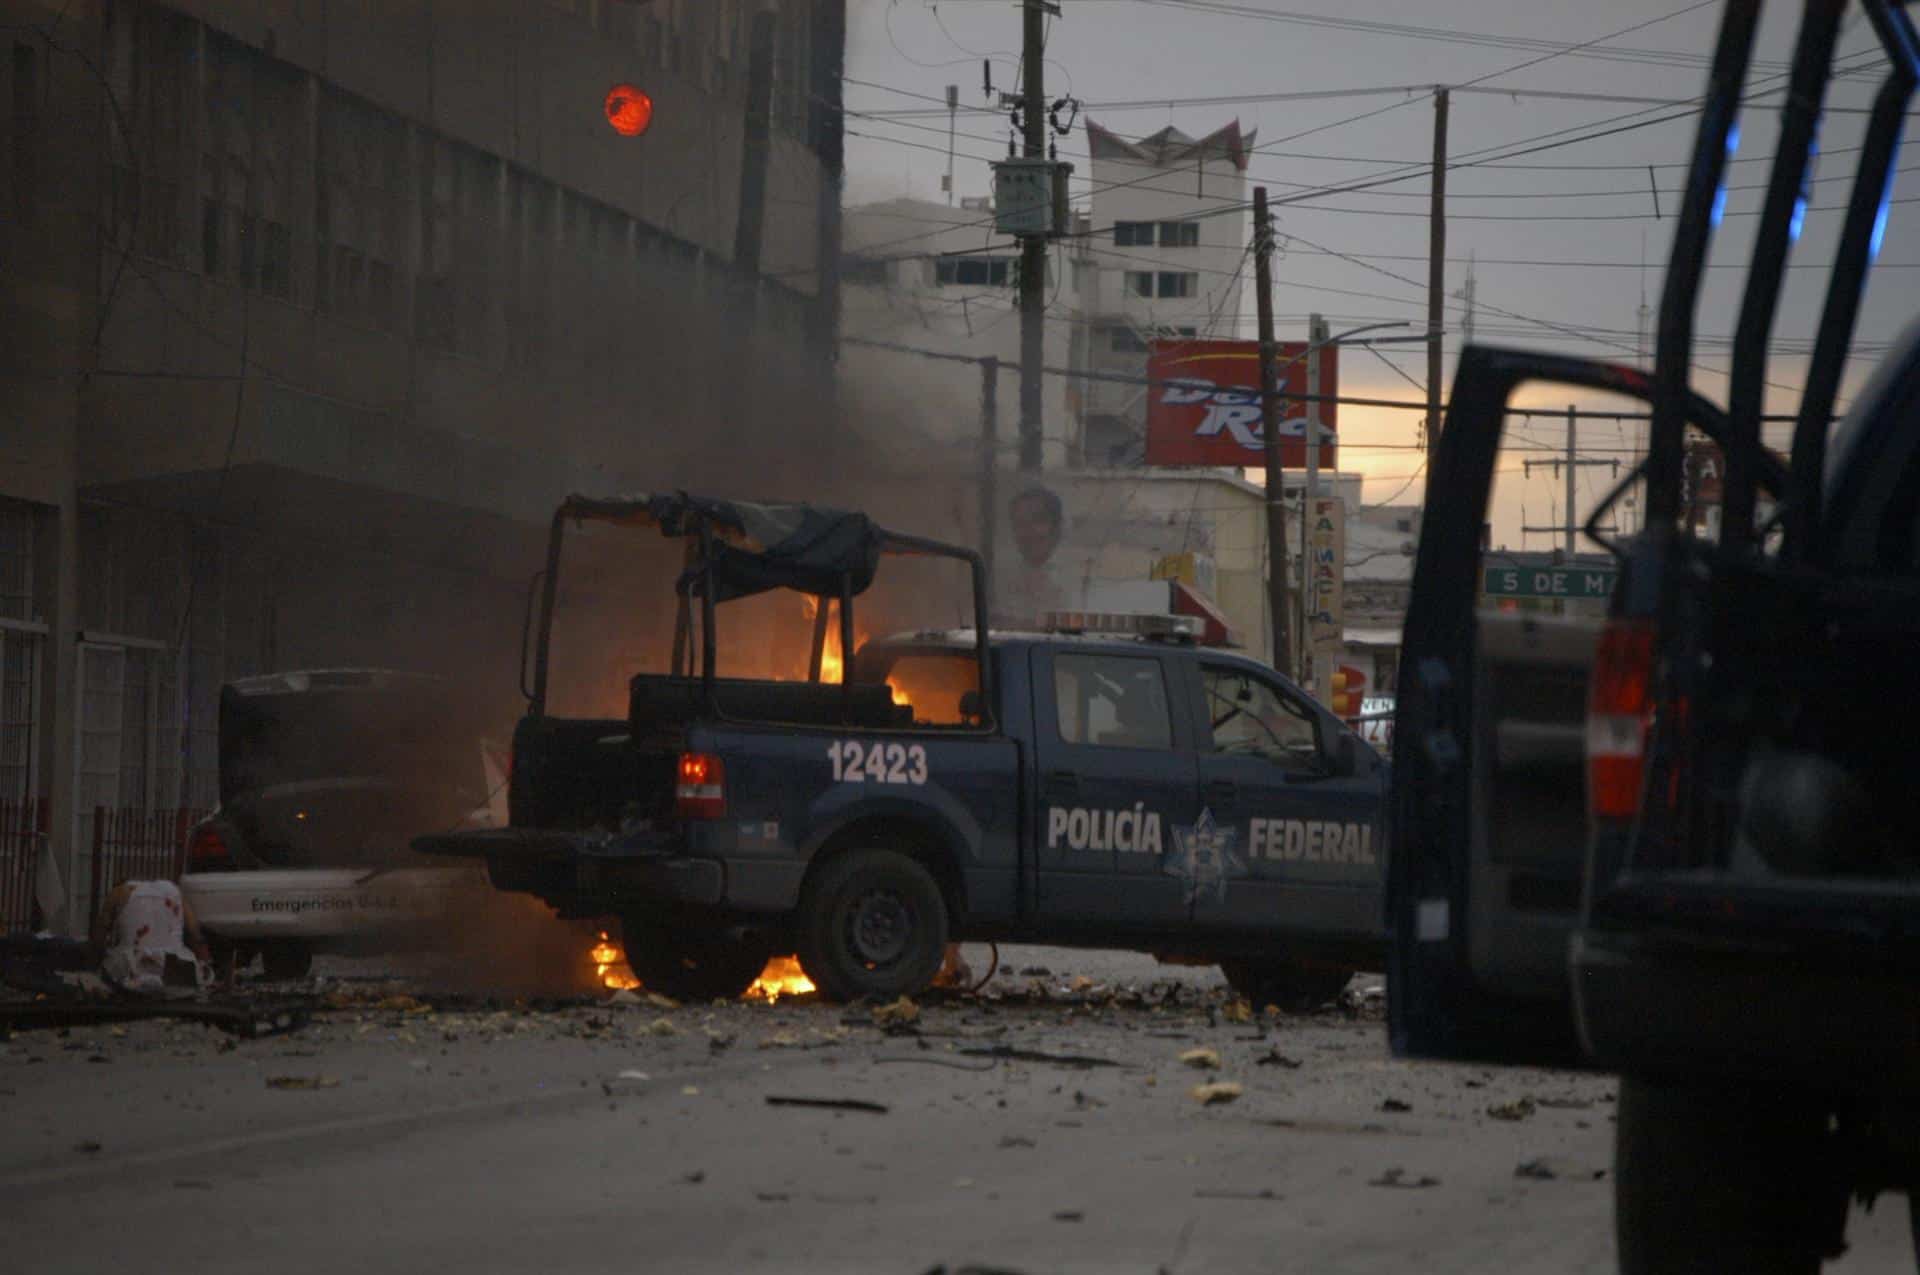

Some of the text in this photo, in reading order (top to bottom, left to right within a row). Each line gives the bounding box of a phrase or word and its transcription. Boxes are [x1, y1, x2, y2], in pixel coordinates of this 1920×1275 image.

[1503, 572, 1519, 591] 5
[1535, 572, 1568, 593] DE
[827, 740, 928, 784] 12423
[1048, 801, 1375, 864] POLICÍA FEDERAL
